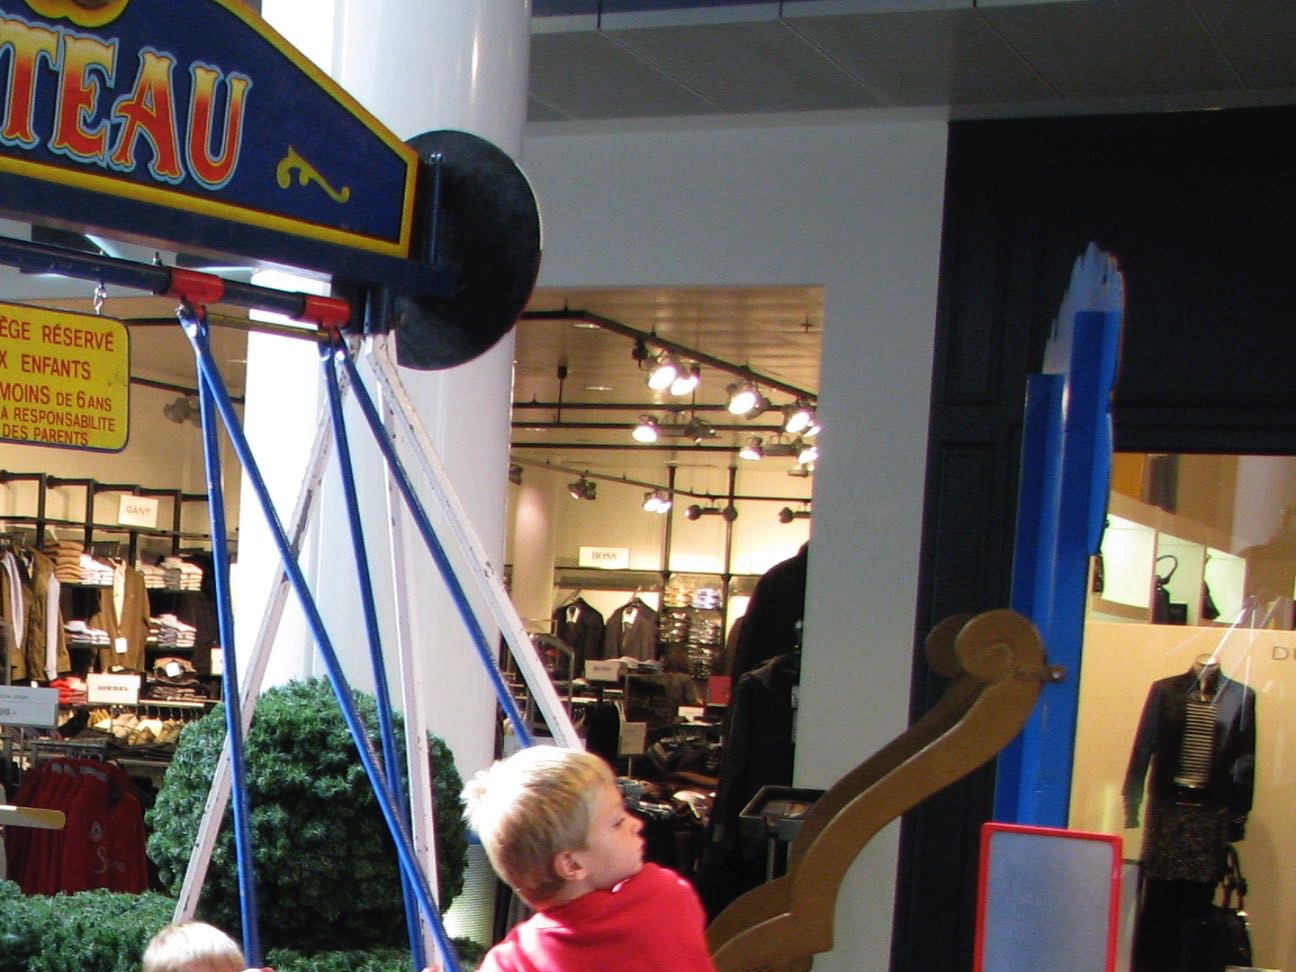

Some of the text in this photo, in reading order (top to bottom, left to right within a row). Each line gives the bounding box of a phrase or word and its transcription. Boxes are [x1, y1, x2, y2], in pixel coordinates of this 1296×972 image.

[42, 323, 115, 352] RÉSERVÉ
[21, 354, 92, 380] ENFANTS
[56, 392, 73, 408] DE
[13, 408, 116, 432] RESPONSABILITE
[2, 423, 89, 446] DES PARENTS
